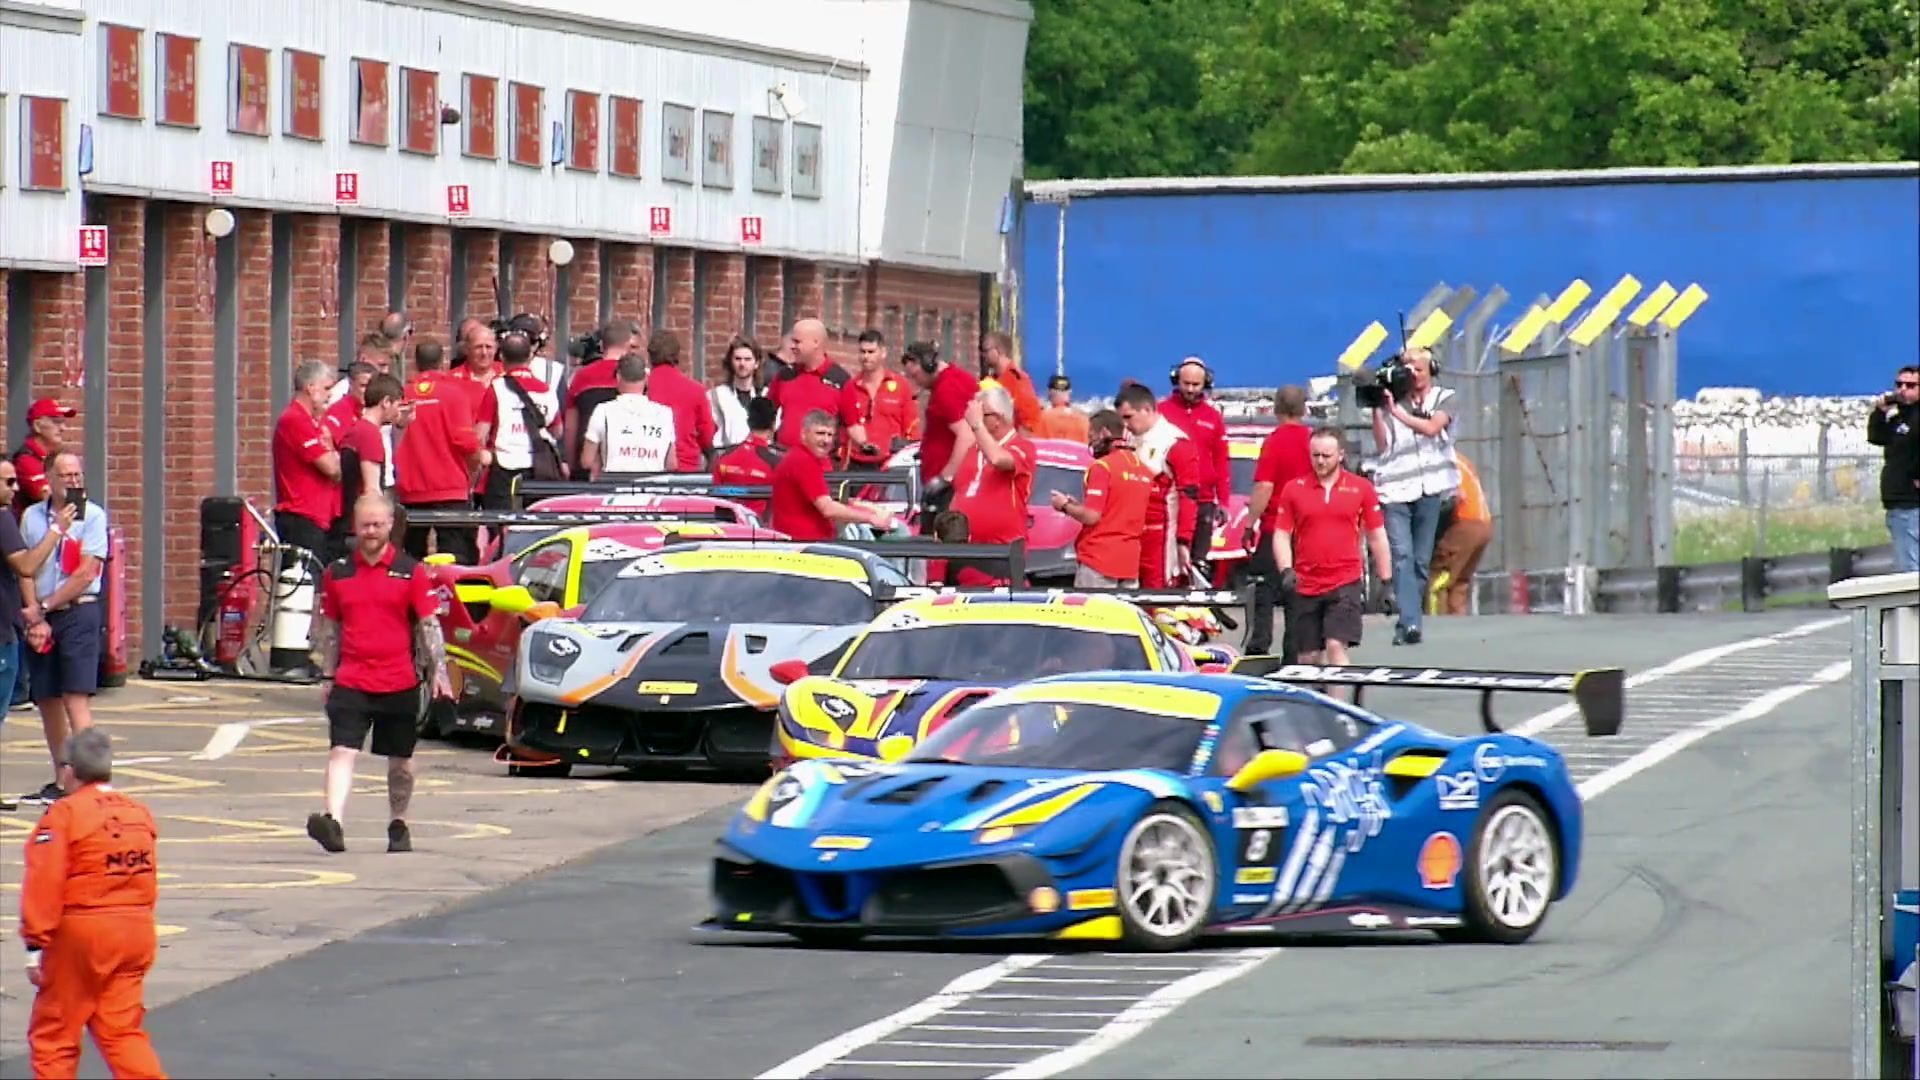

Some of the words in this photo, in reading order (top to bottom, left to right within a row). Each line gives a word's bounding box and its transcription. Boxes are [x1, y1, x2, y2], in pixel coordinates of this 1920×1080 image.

[618, 446, 659, 459] MEDIA
[1245, 829, 1272, 862] 8
[105, 849, 152, 869] NGK
